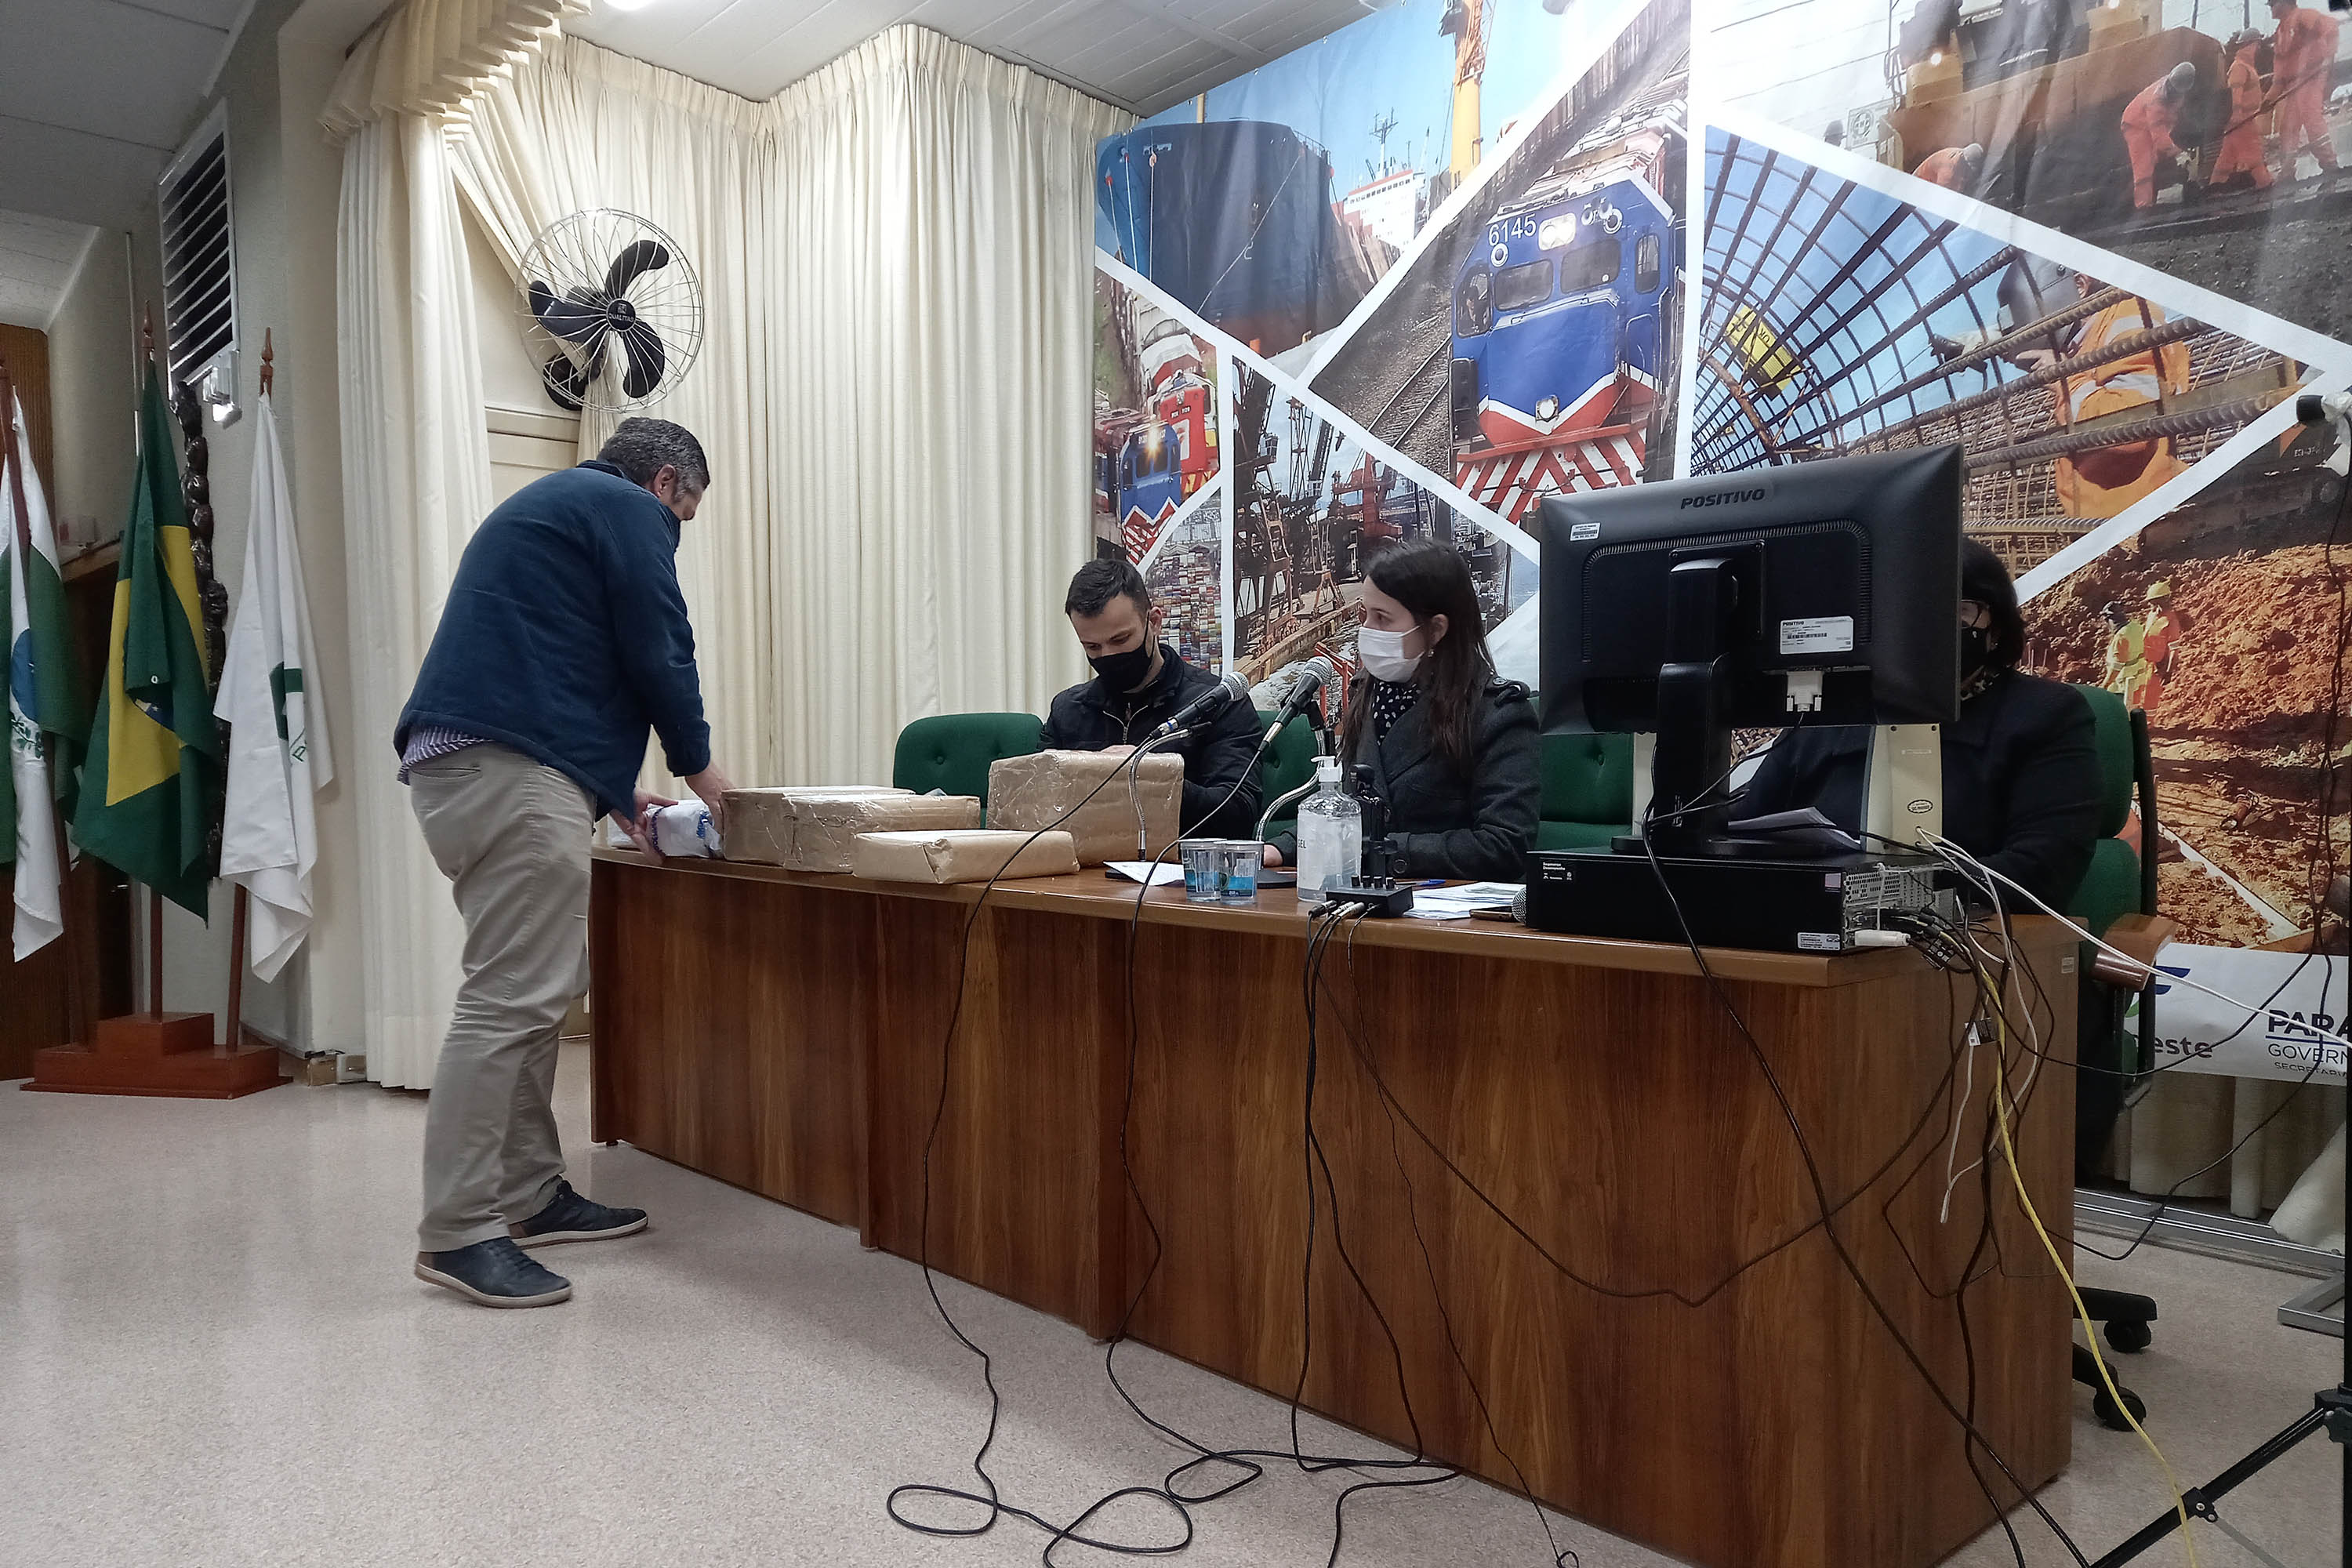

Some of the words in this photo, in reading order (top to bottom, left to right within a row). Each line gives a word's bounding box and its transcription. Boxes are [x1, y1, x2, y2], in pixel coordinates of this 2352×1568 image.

[1488, 212, 1537, 246] 6145
[608, 312, 634, 323] QUALITAS
[1680, 488, 1766, 510] POSITIVO
